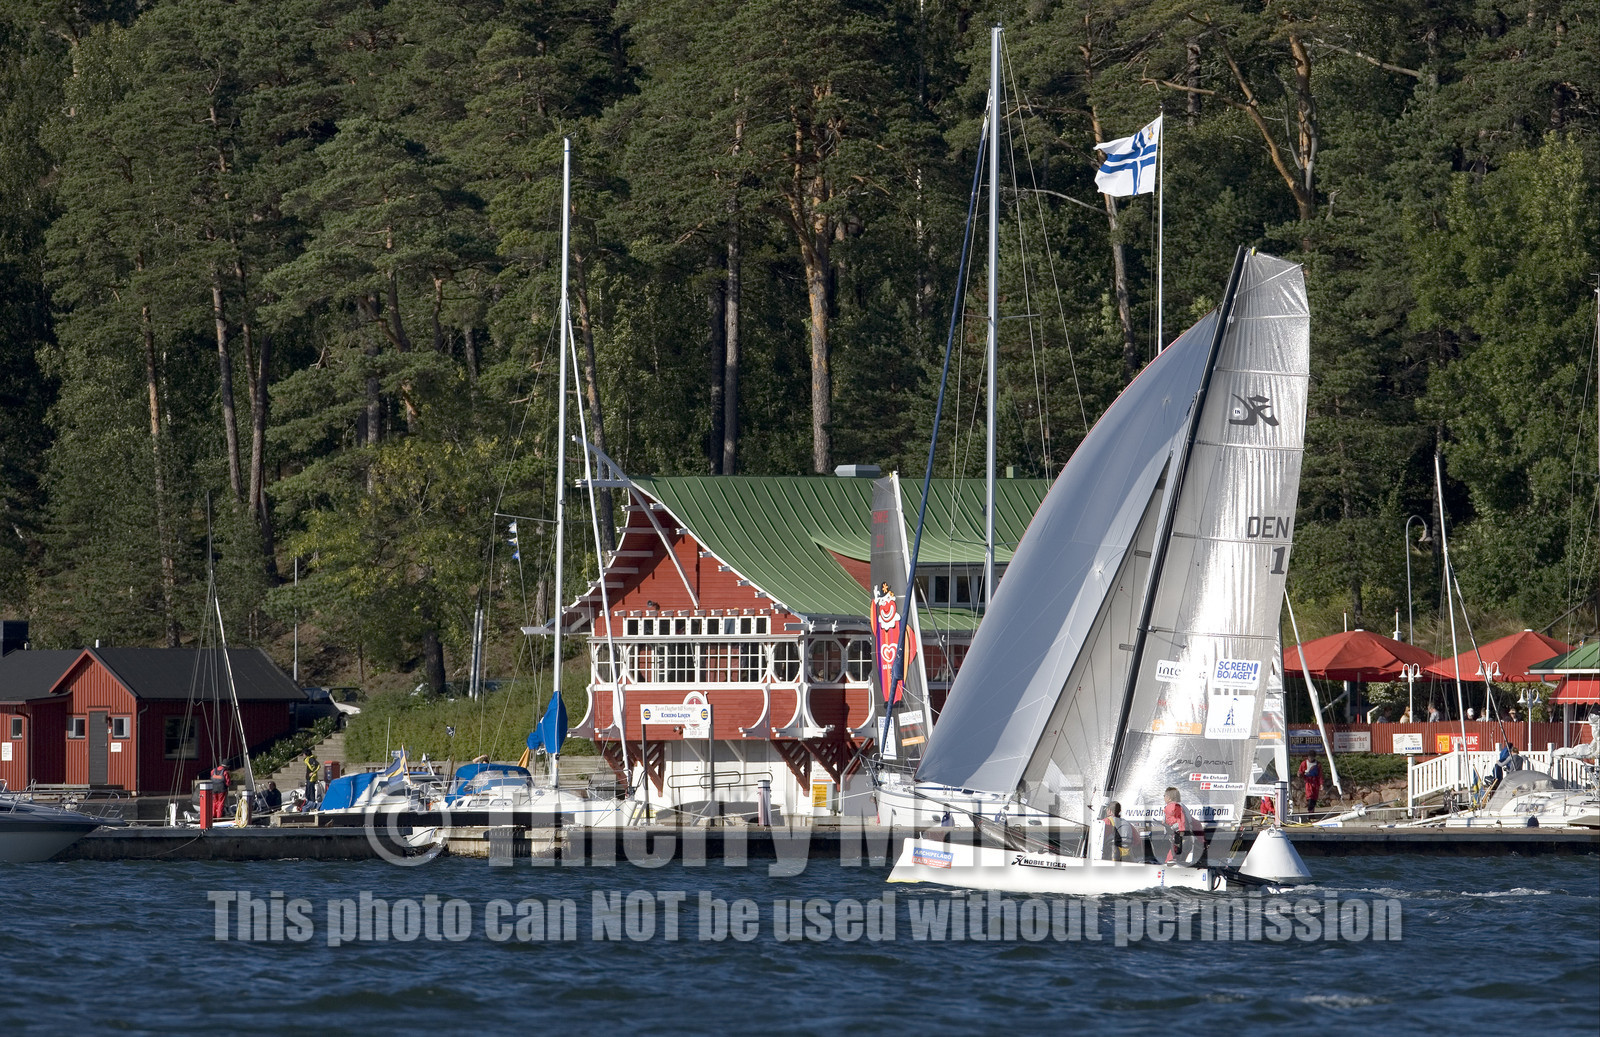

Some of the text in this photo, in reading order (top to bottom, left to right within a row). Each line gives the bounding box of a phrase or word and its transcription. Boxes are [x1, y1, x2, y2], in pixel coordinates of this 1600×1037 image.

[1247, 516, 1290, 539] DEN
[1270, 546, 1285, 575] 1
[1218, 660, 1253, 671] SCREEN
[914, 849, 952, 860] ARCHIPELAGO
[1046, 860, 1067, 868] TIGER
